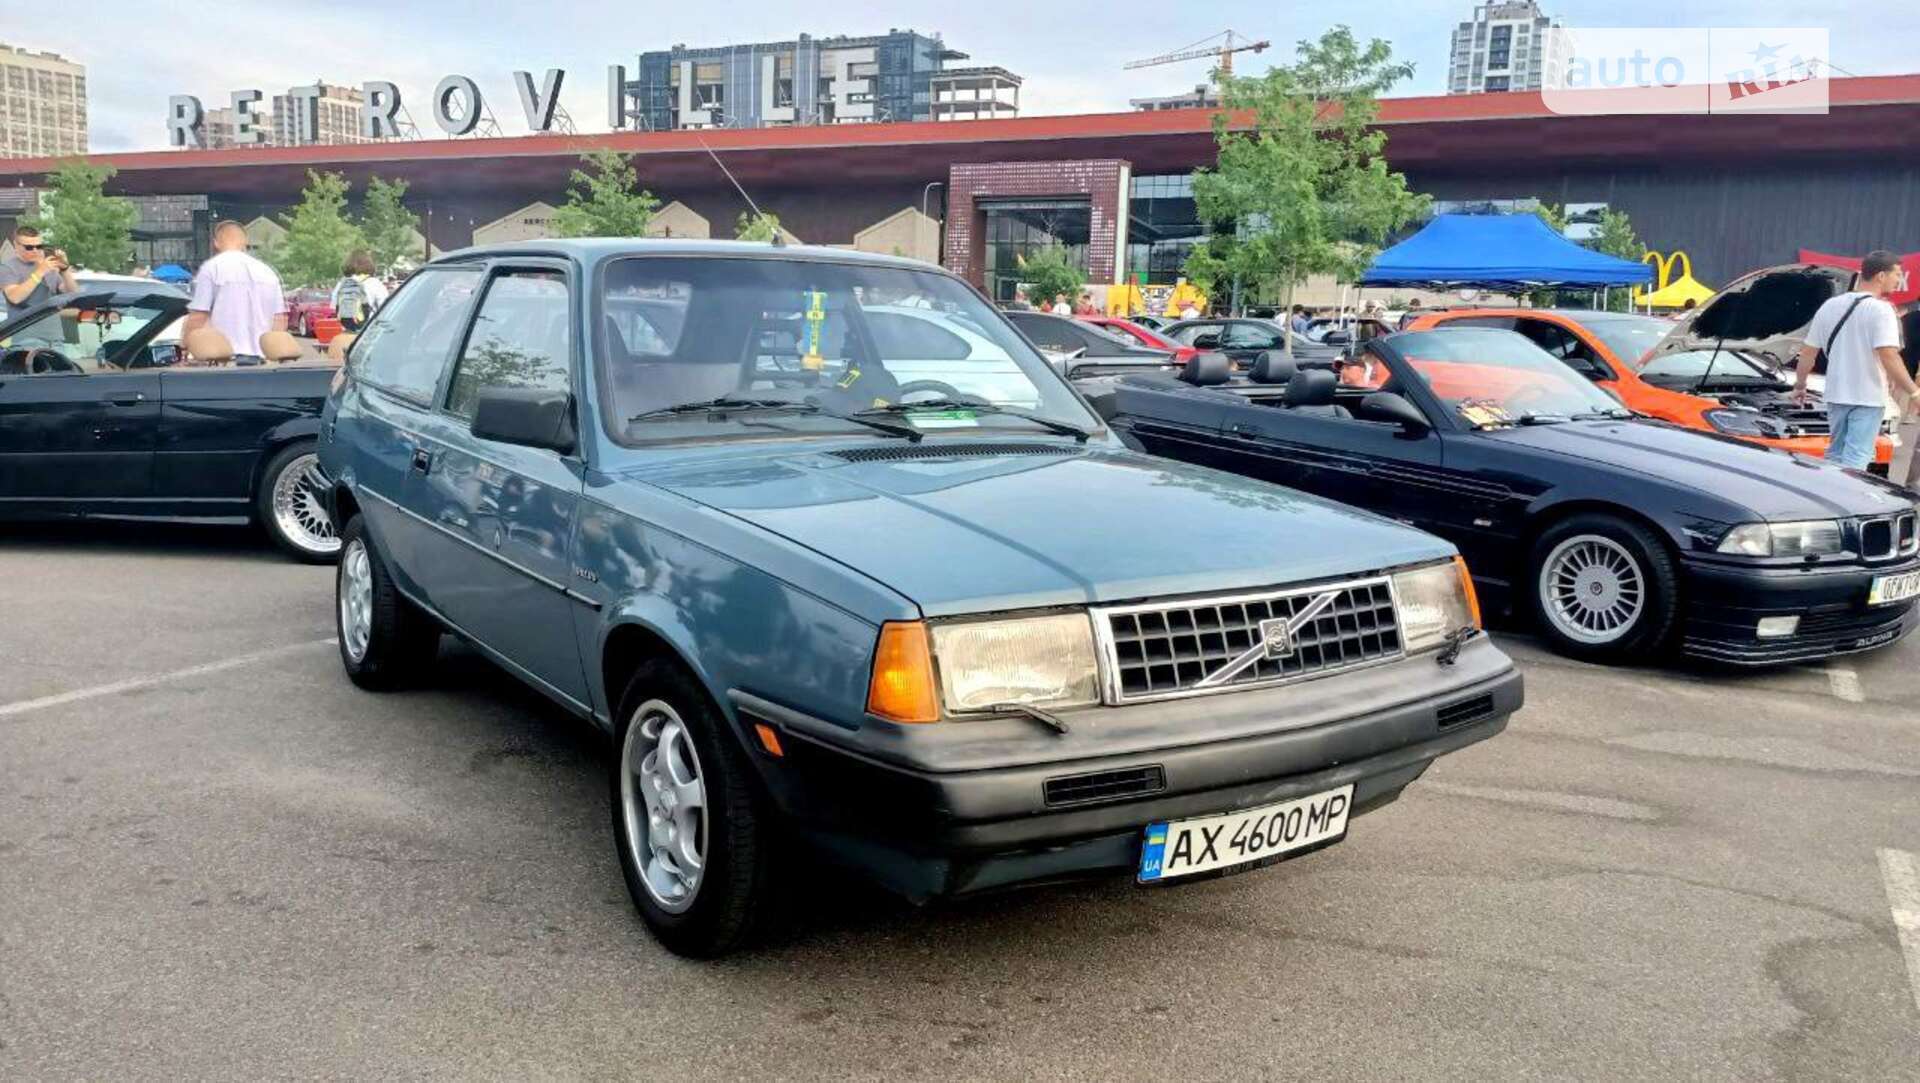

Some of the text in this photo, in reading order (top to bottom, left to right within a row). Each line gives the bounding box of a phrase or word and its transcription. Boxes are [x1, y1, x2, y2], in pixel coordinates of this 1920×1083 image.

[167, 47, 878, 147] RETROVILLE
[1144, 858, 1160, 872] UA
[1168, 824, 1224, 869] AX
[1229, 806, 1302, 855] 4600
[1305, 794, 1346, 837] MP
